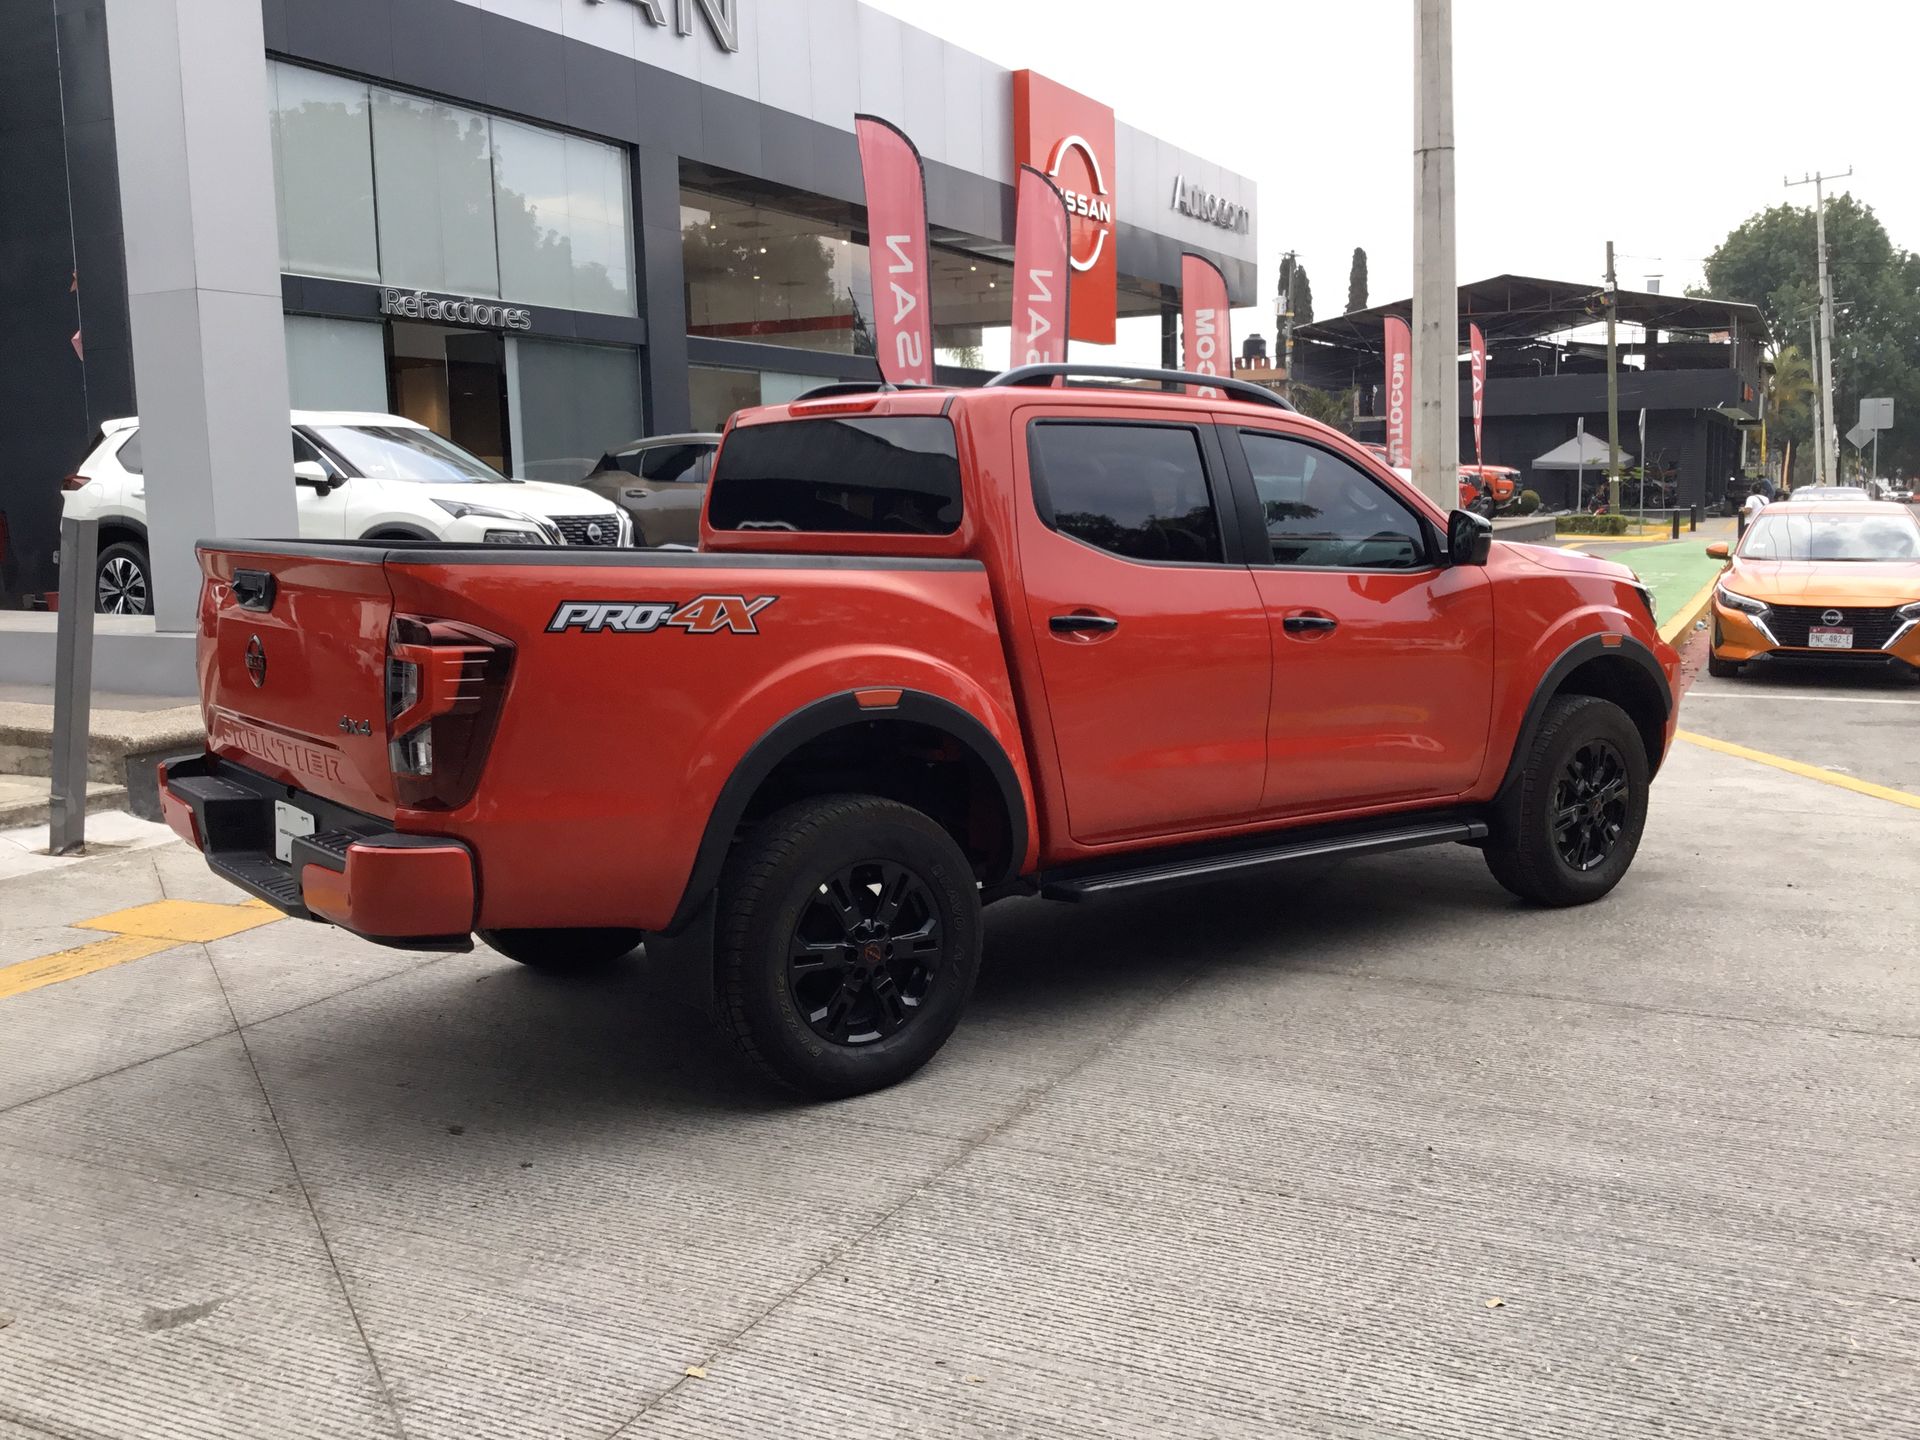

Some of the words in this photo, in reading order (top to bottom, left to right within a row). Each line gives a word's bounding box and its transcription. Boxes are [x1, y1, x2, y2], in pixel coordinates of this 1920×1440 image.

[380, 287, 532, 330] Refacciones
[544, 594, 780, 634] PRO-4X
[219, 716, 346, 785] FRONTIER
